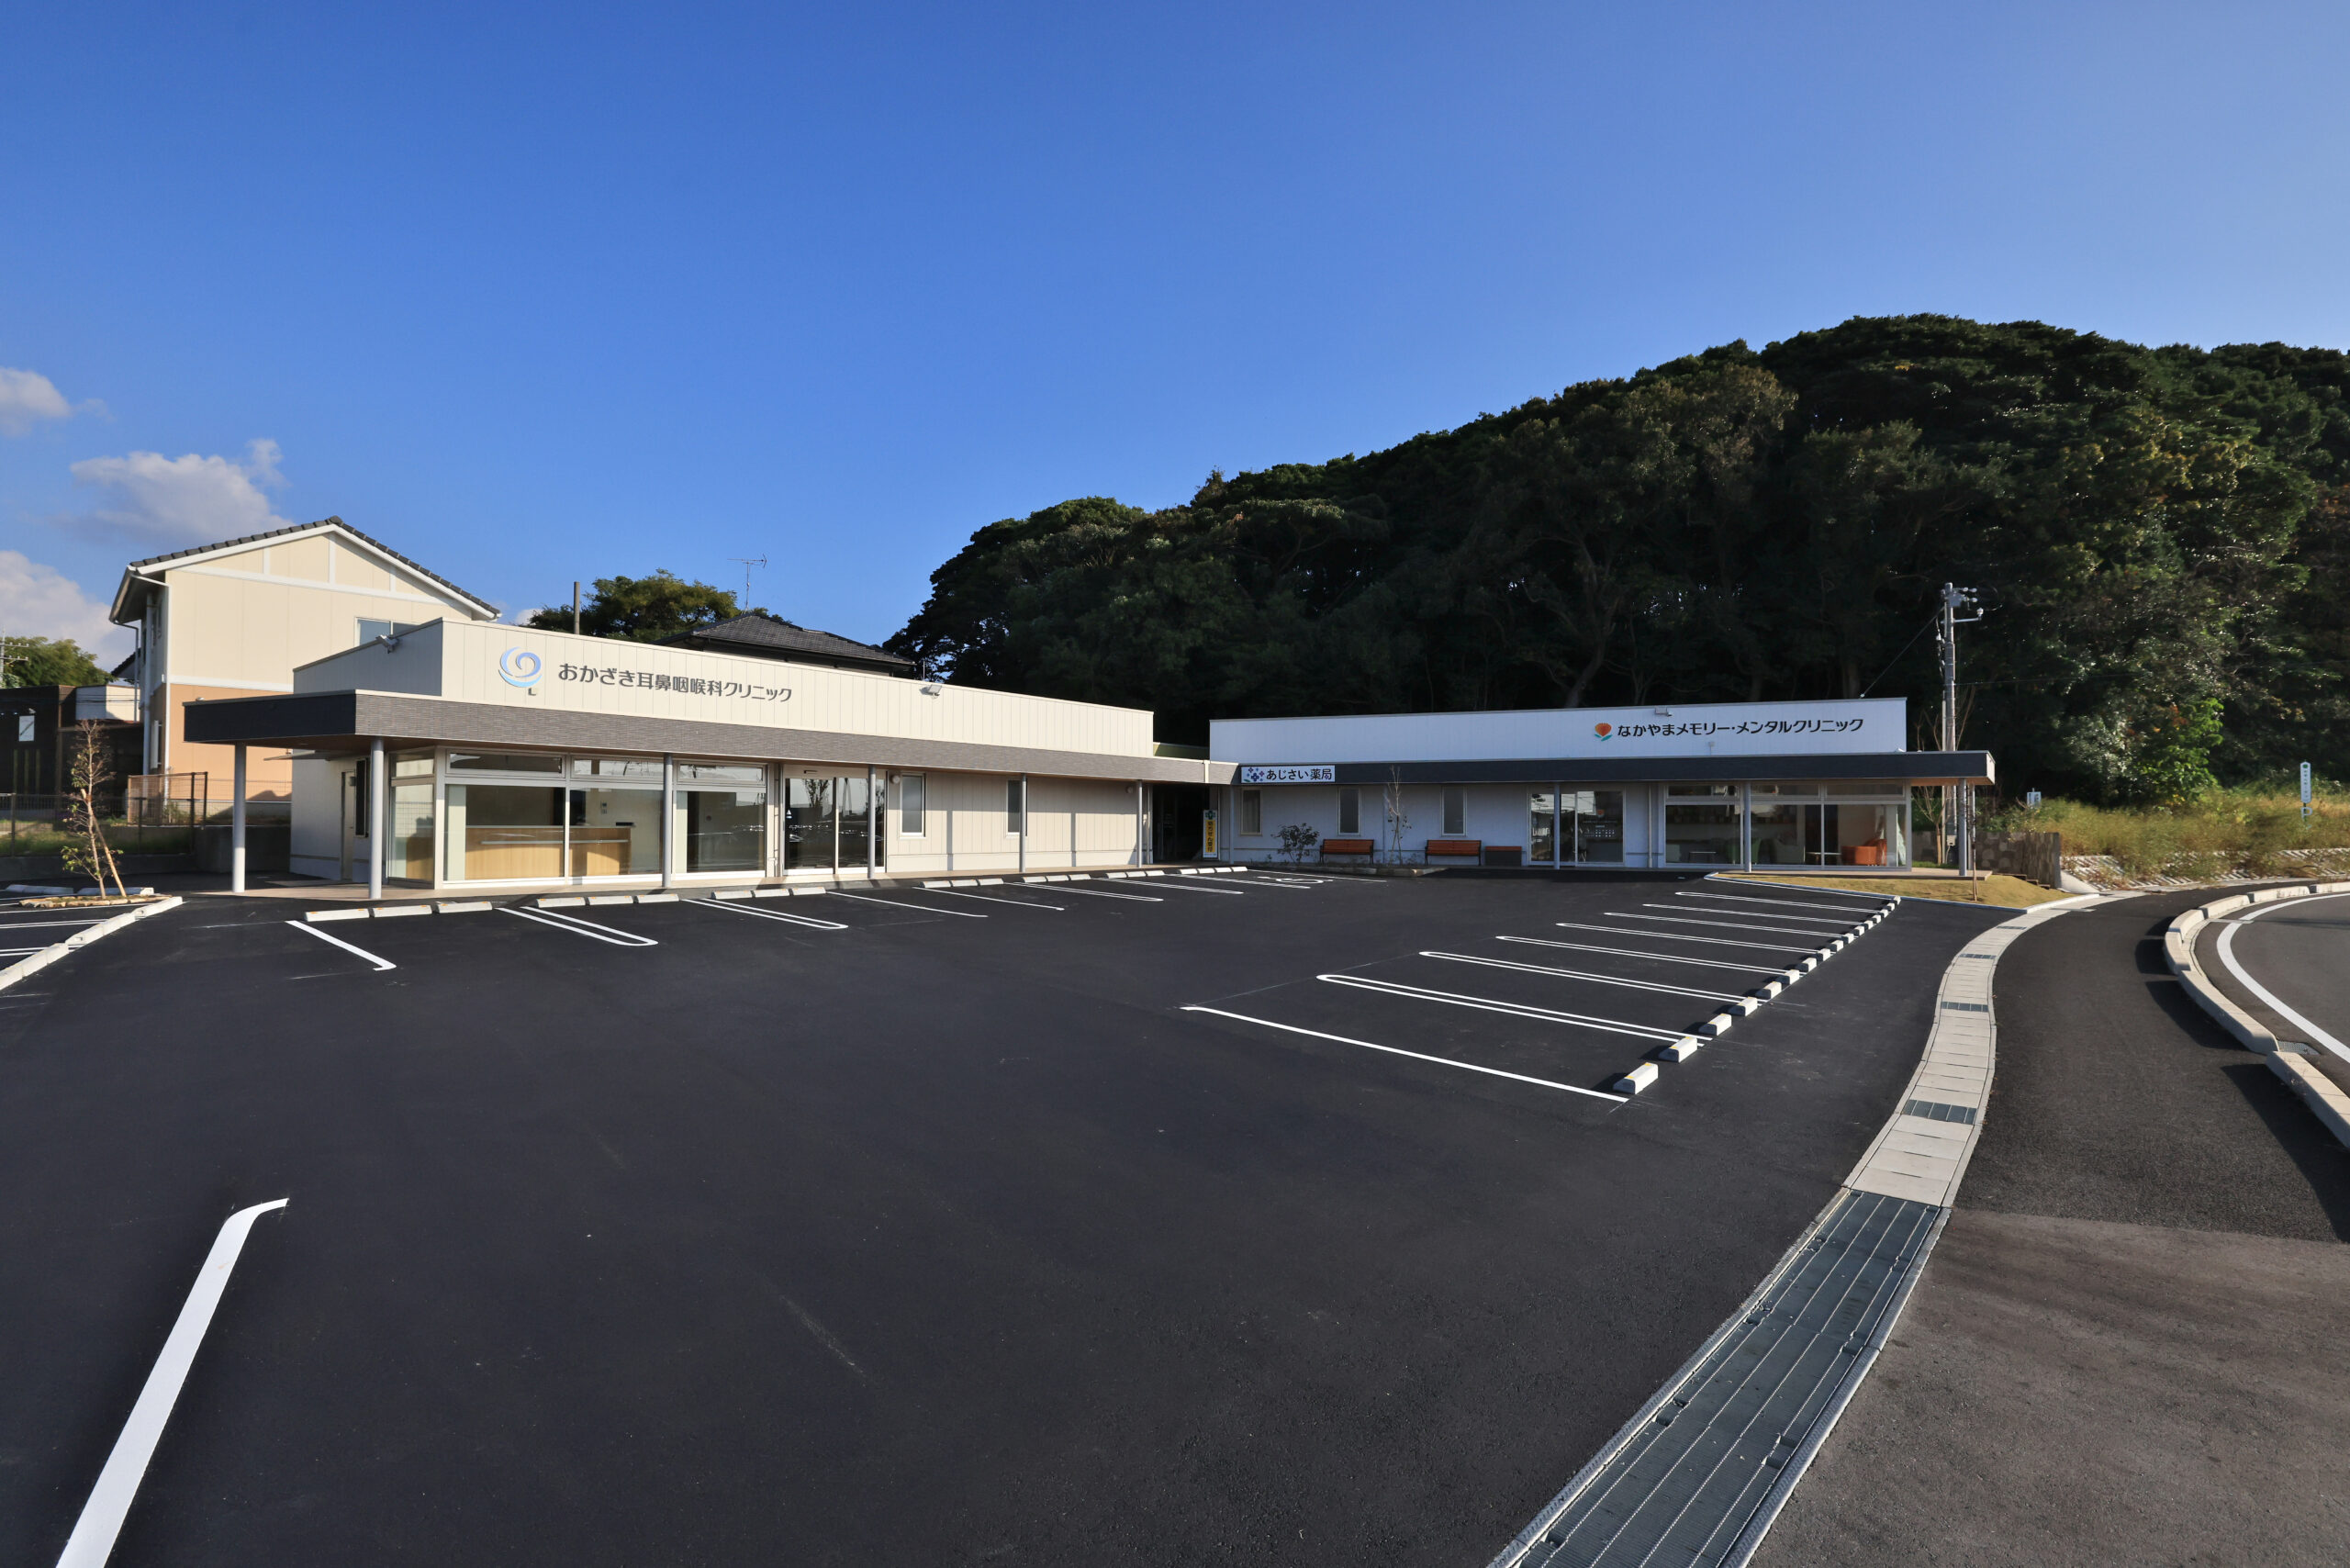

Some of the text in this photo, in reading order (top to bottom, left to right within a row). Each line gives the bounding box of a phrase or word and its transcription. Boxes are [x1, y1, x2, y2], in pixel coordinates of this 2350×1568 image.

[558, 663, 792, 702] おかざき耳鼻咽喉科クリニック
[1617, 719, 1863, 737] なかやまメモリー・メンタルクリニック
[1266, 768, 1332, 780] あじさい薬局
